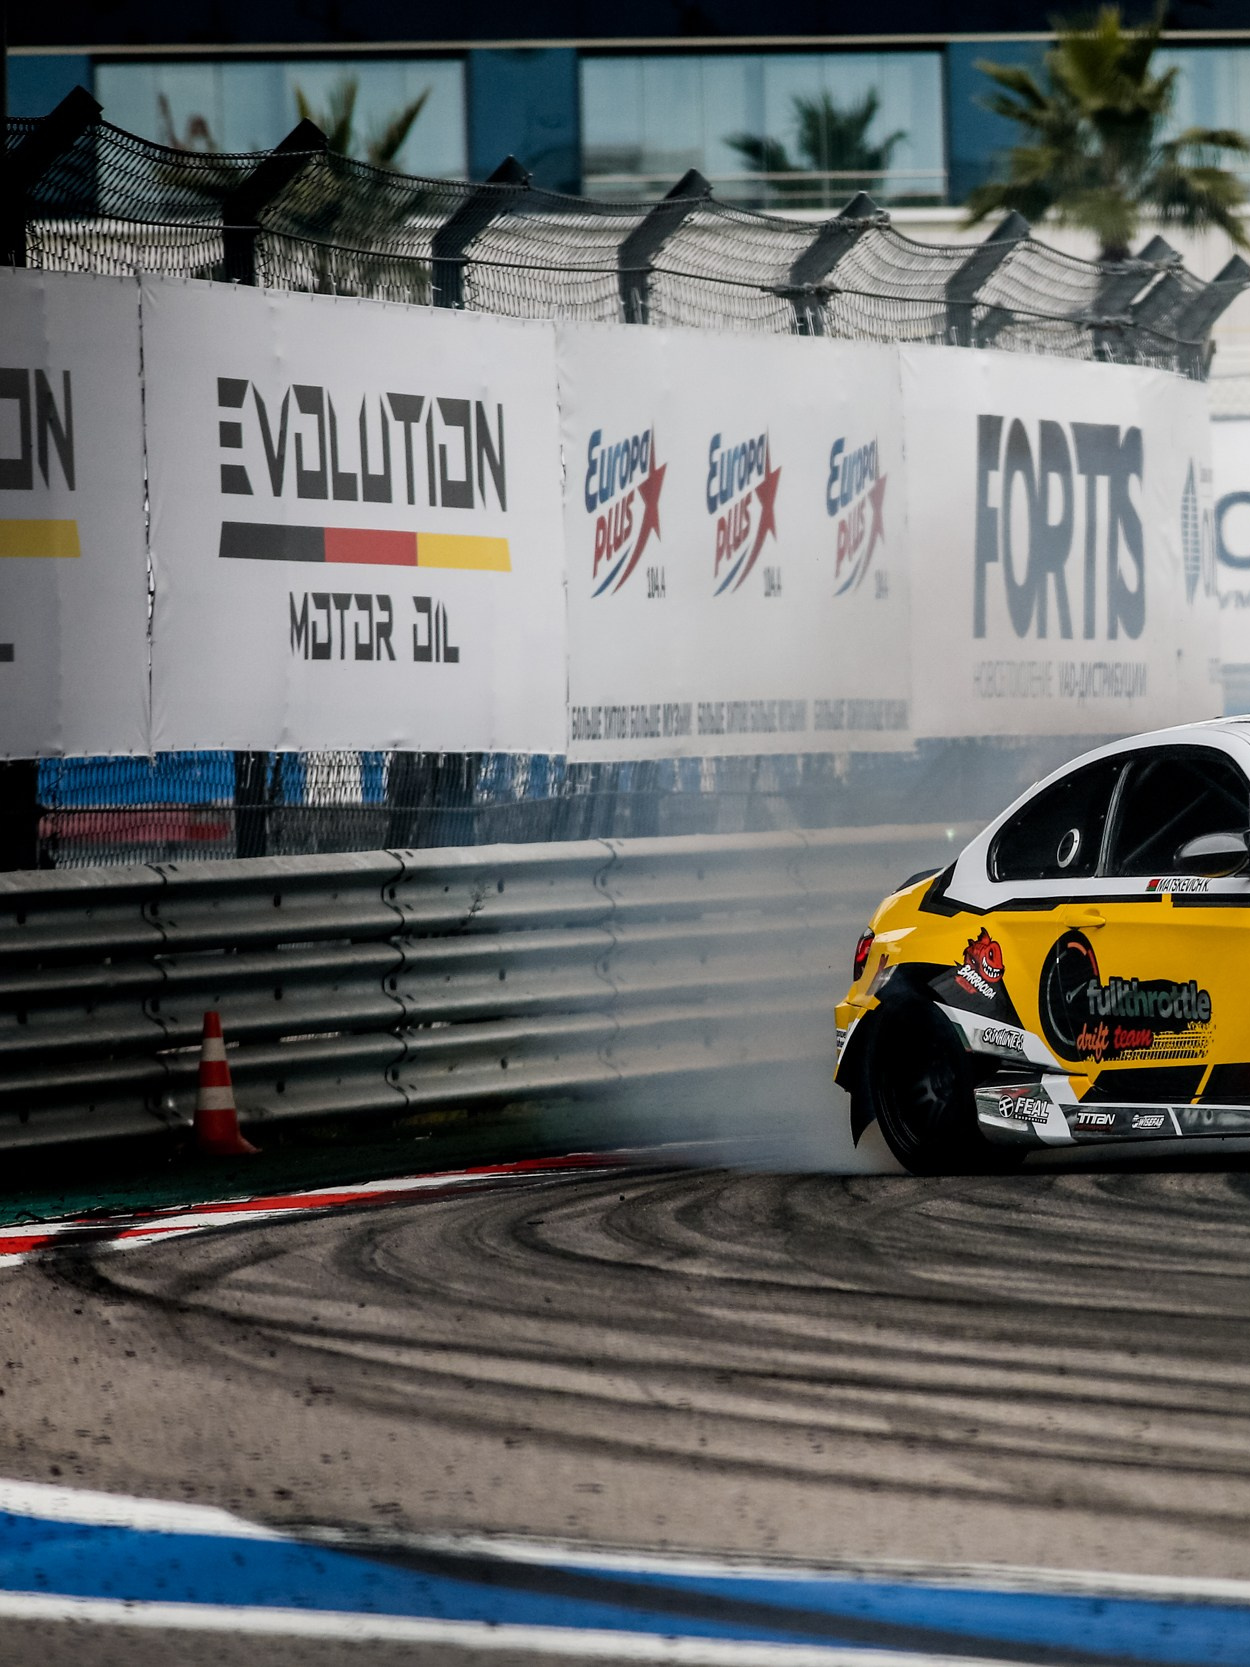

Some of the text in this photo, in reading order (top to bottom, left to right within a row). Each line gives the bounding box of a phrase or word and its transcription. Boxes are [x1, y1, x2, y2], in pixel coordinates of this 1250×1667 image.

[217, 377, 508, 512] EVOLUTION
[973, 414, 1147, 641] FORTIS
[290, 591, 460, 663] MOTOR OIL
[956, 964, 997, 1000] BARRACUDA
[1086, 978, 1212, 1020] fullthrottle
[1077, 1021, 1153, 1060] drift team
[1014, 1097, 1049, 1118] FEAL
[1077, 1112, 1116, 1125] TITAN
